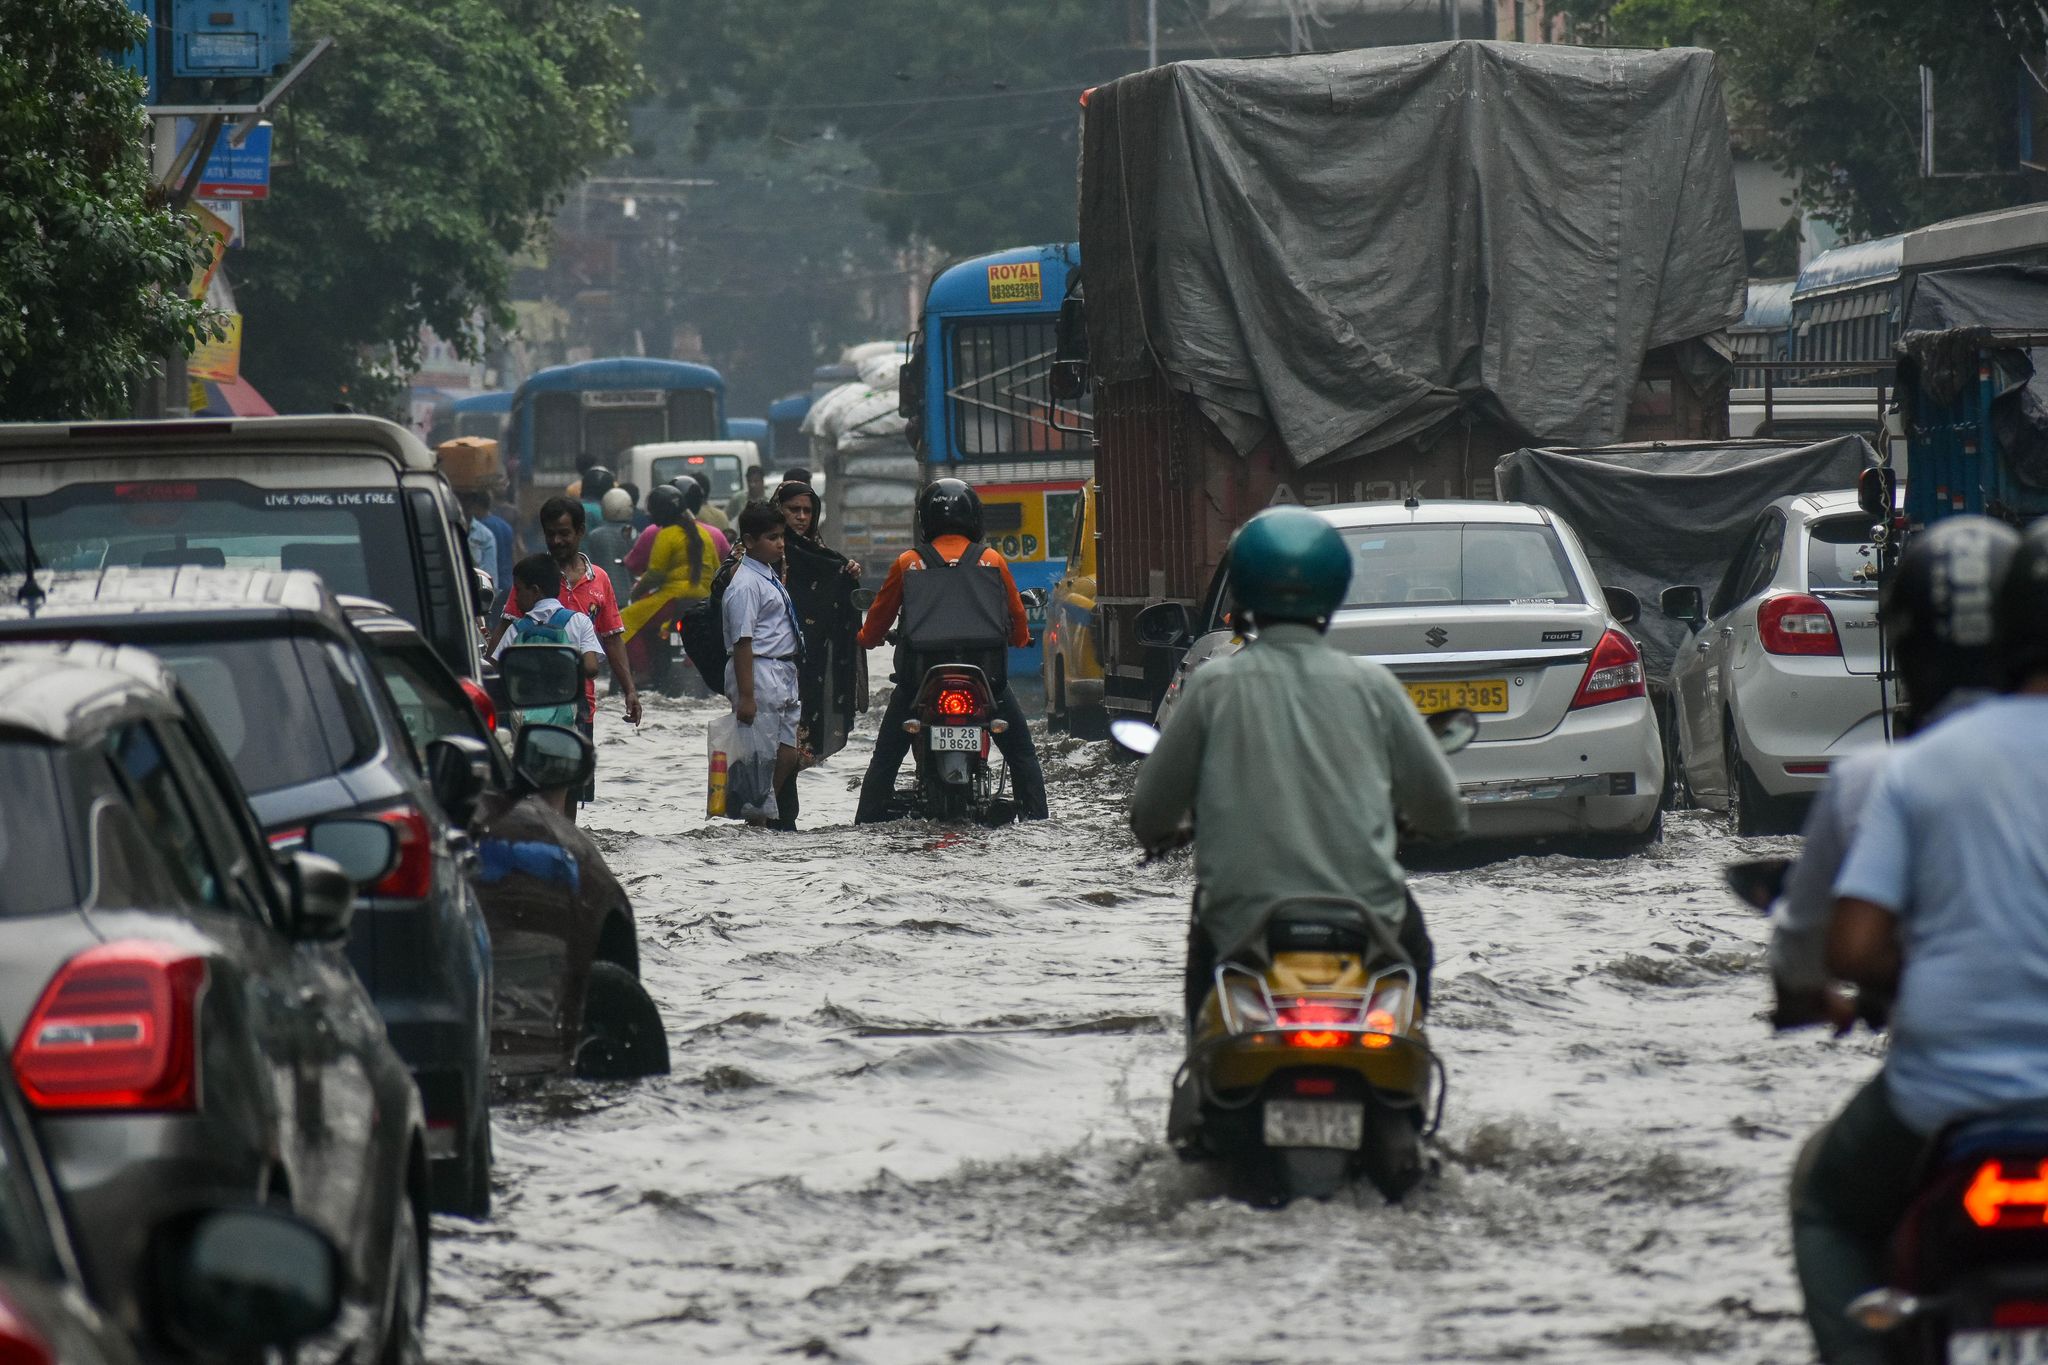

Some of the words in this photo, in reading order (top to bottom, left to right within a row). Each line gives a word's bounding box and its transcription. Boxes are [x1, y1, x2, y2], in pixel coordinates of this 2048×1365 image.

[990, 264, 1038, 280] ROYAL
[265, 494, 290, 506] LIVE
[293, 494, 333, 505] YOUNG
[337, 493, 362, 505] LIVE
[365, 492, 395, 504] FREE
[1269, 479, 1426, 505] ASHOK
[1570, 632, 1580, 640] S
[1456, 687, 1503, 707] 3385
[940, 728, 954, 738] WB
[961, 728, 975, 739] 28
[940, 739, 946, 749] D
[949, 739, 978, 750] 8628
